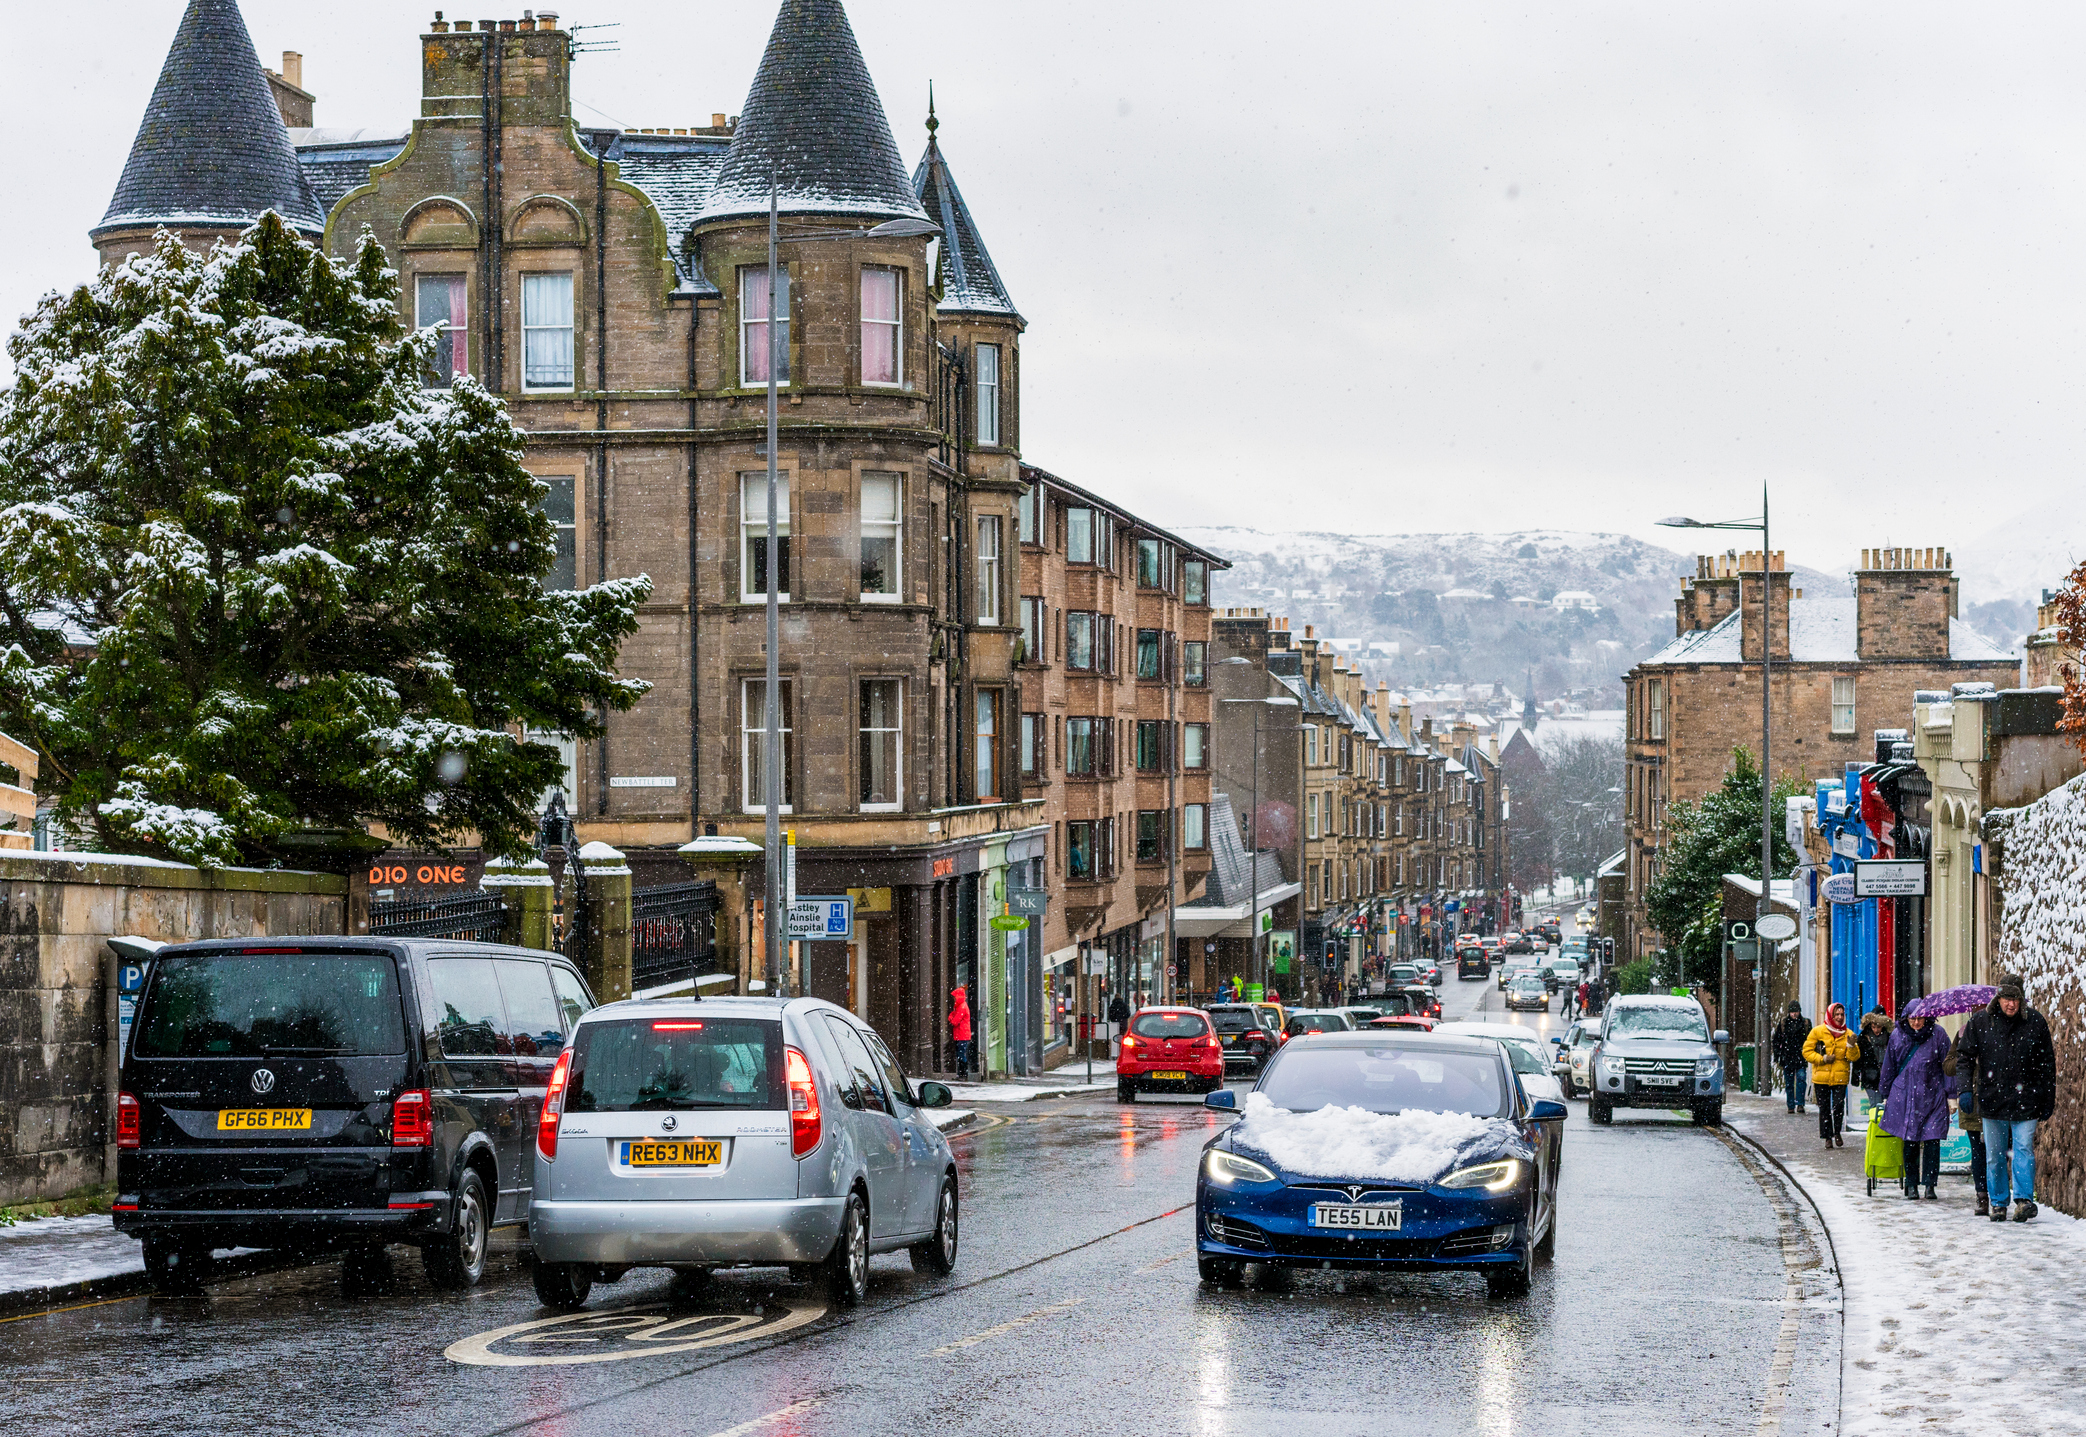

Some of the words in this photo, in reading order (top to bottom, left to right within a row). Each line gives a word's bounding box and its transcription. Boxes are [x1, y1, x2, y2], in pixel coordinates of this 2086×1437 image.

[416, 866, 466, 884] ONE
[832, 904, 842, 916] H
[1020, 898, 1036, 908] RK
[790, 913, 820, 921] Ainslie
[126, 966, 140, 988] P
[225, 1111, 267, 1127] GF66
[272, 1110, 305, 1126] PHX
[632, 1144, 678, 1161] RE63
[683, 1144, 718, 1161] NHX
[1318, 1208, 1360, 1225] TE55
[1365, 1210, 1397, 1226] LAN
[510, 1314, 763, 1342] 20
